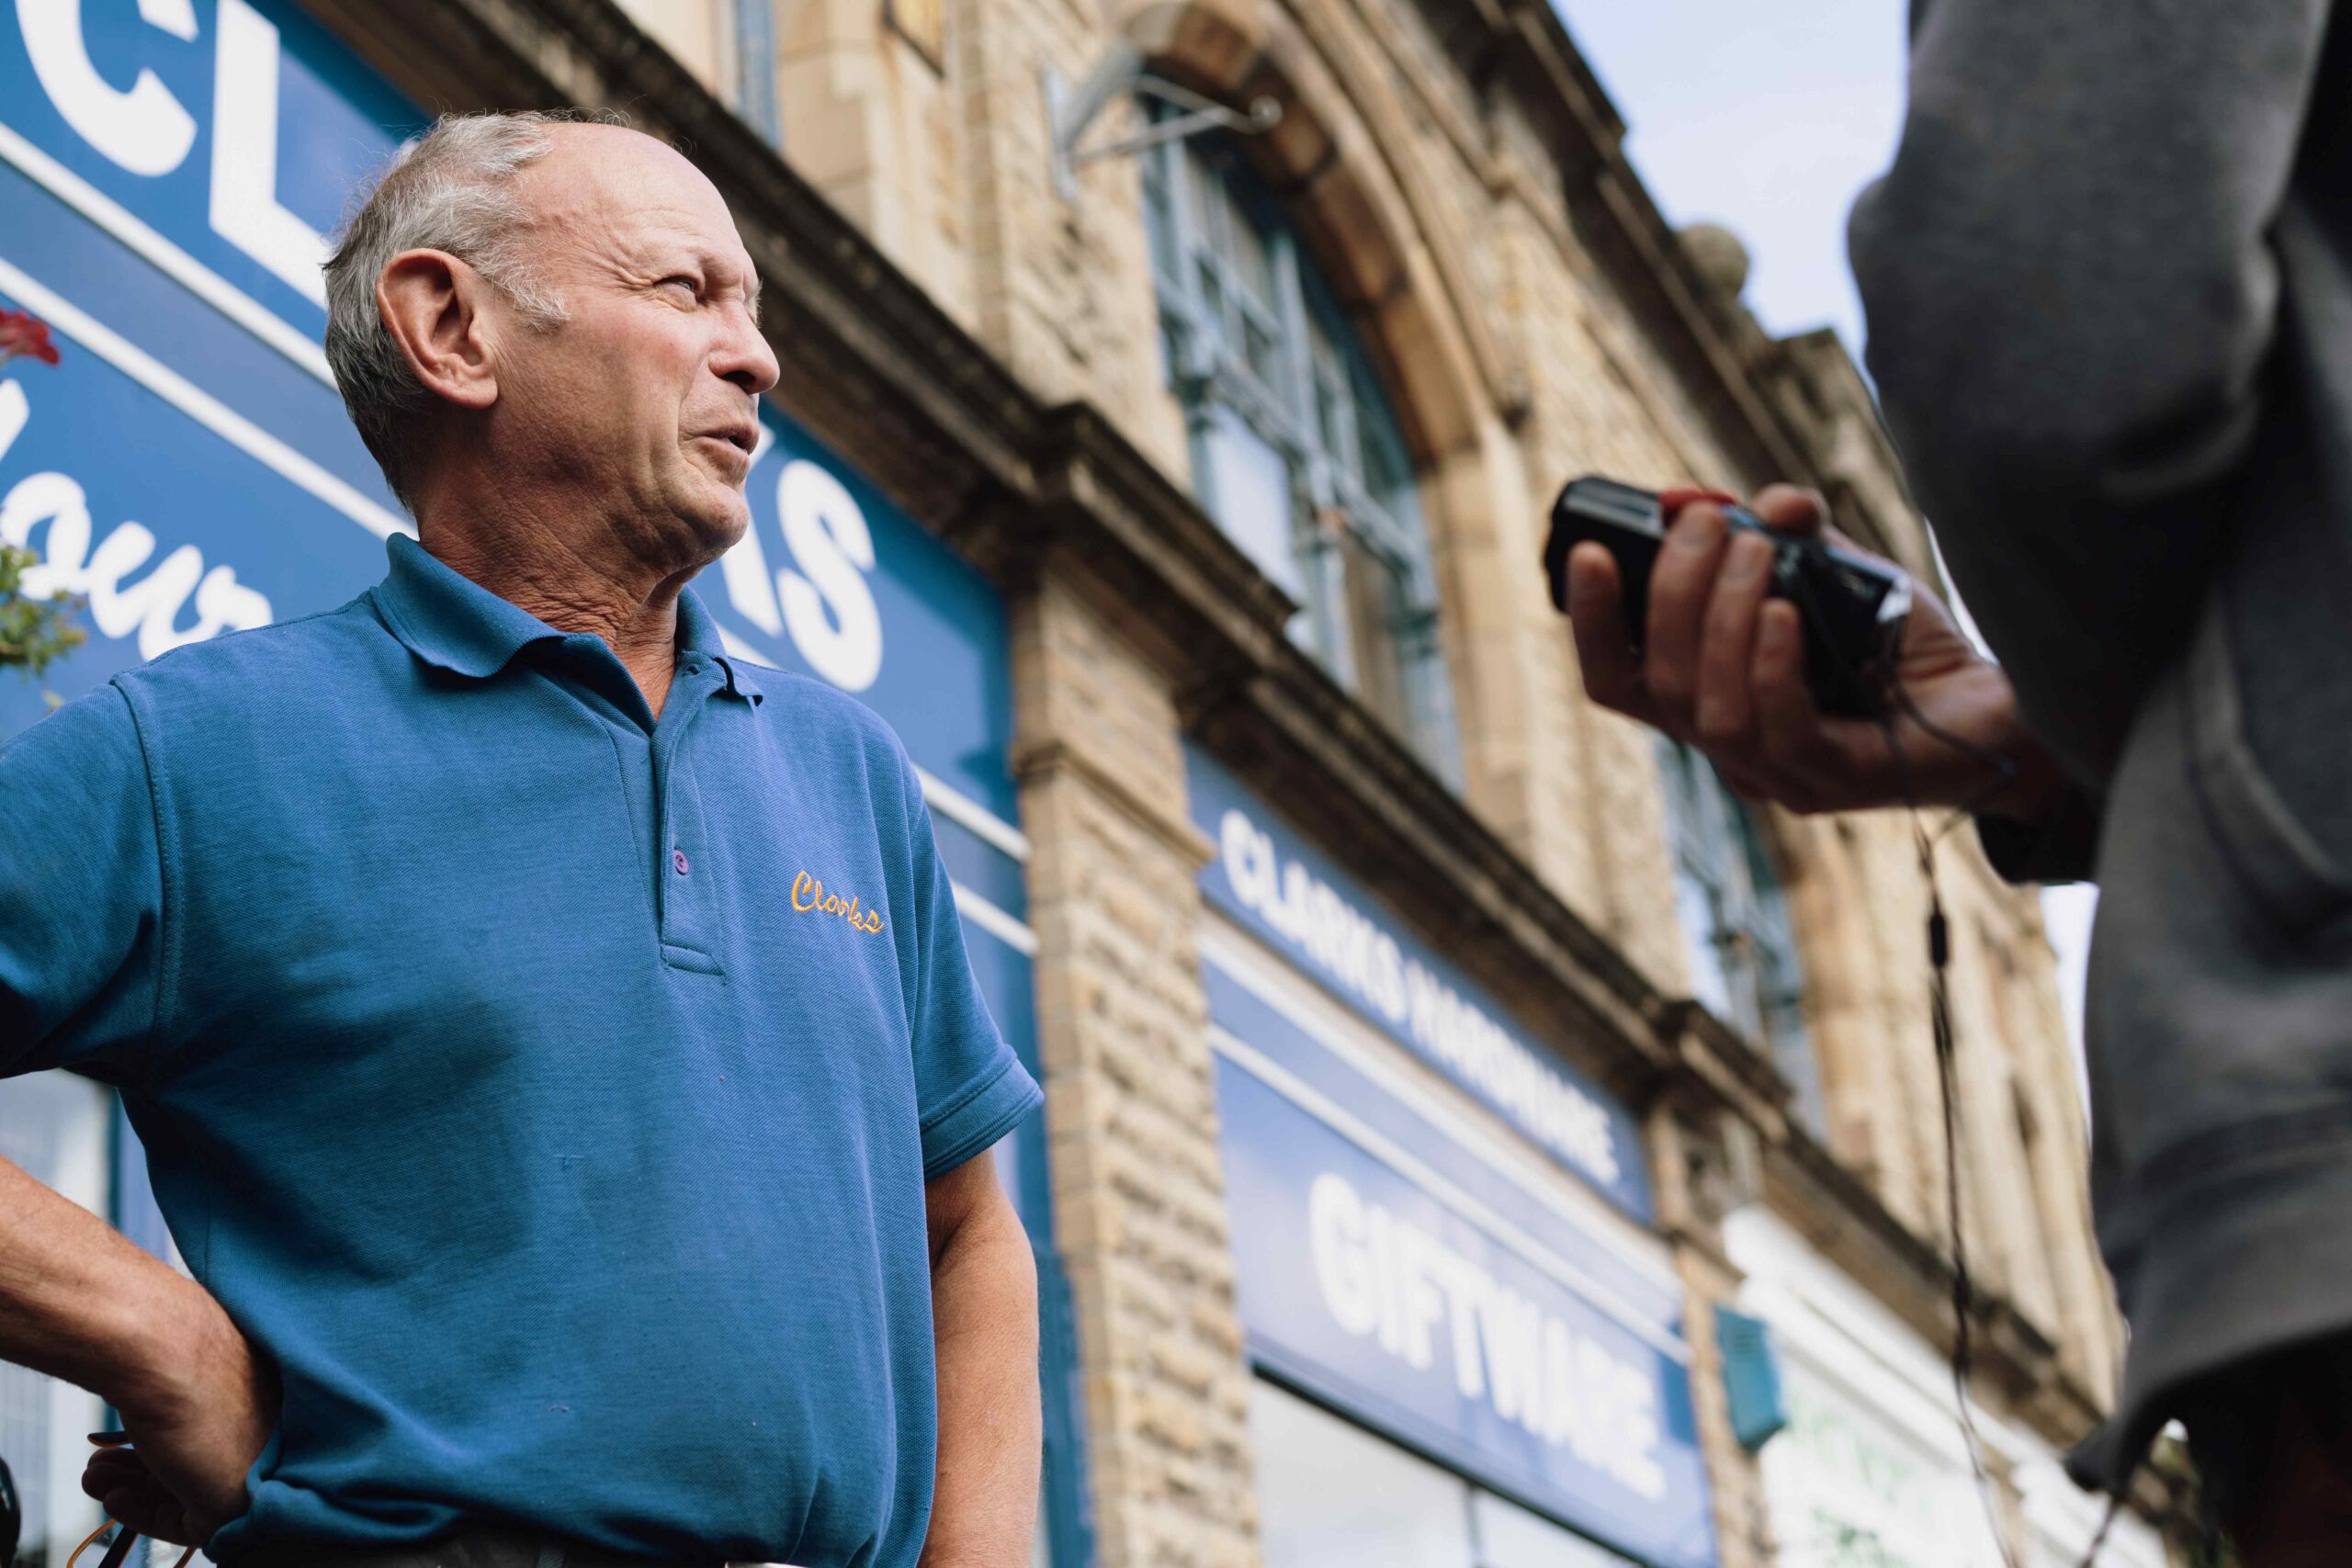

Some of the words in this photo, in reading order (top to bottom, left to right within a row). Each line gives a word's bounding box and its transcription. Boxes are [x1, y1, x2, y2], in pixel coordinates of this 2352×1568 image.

[791, 870, 885, 933] Clarks
[1221, 809, 1408, 1023] CLARKS
[1309, 1172, 1668, 1501] GIFTWARE
